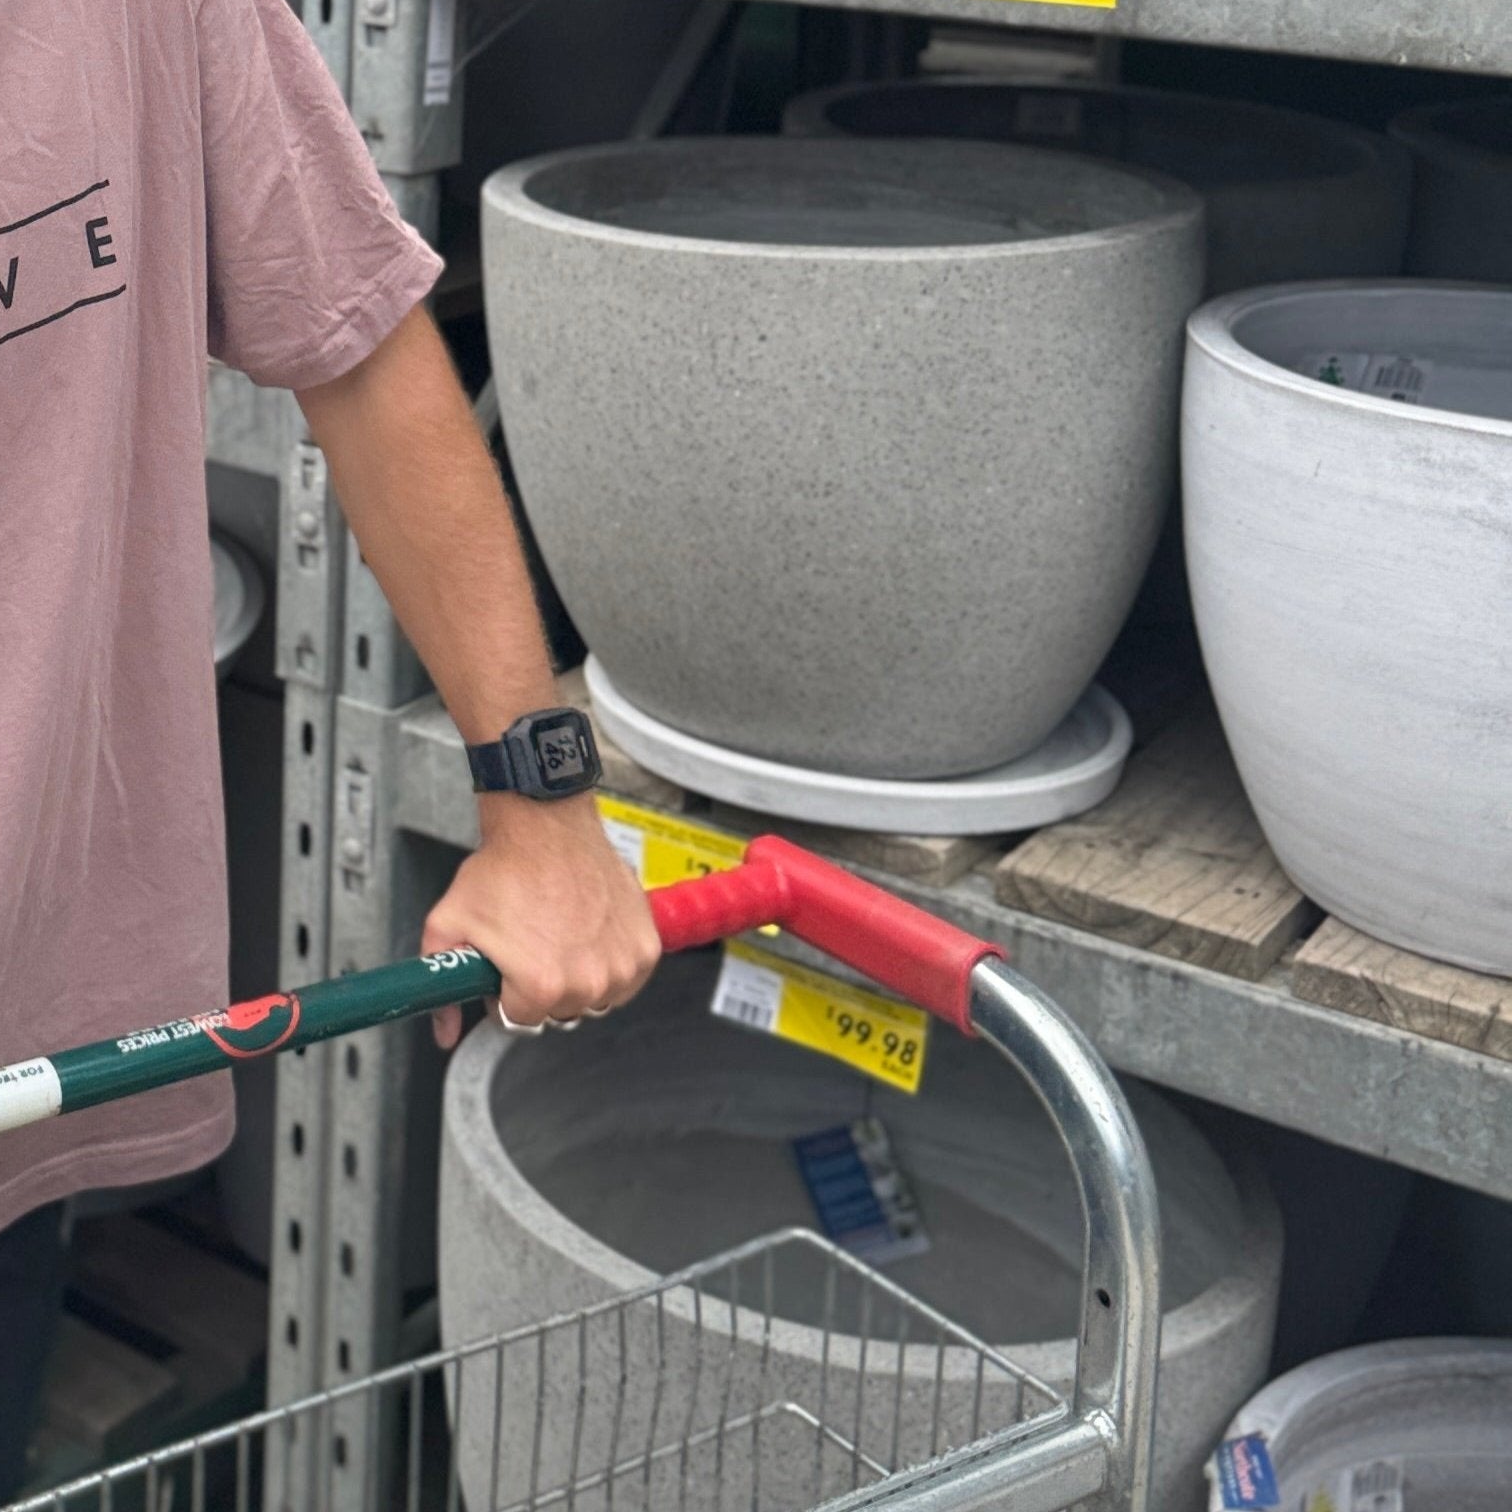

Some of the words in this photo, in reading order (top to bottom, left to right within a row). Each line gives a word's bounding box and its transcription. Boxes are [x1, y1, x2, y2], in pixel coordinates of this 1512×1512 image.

[172, 1013, 231, 1039] LOWEST
[826, 1005, 918, 1066] $99.98
[116, 1030, 170, 1053] PRICES
[18, 1064, 45, 1079] FOR
